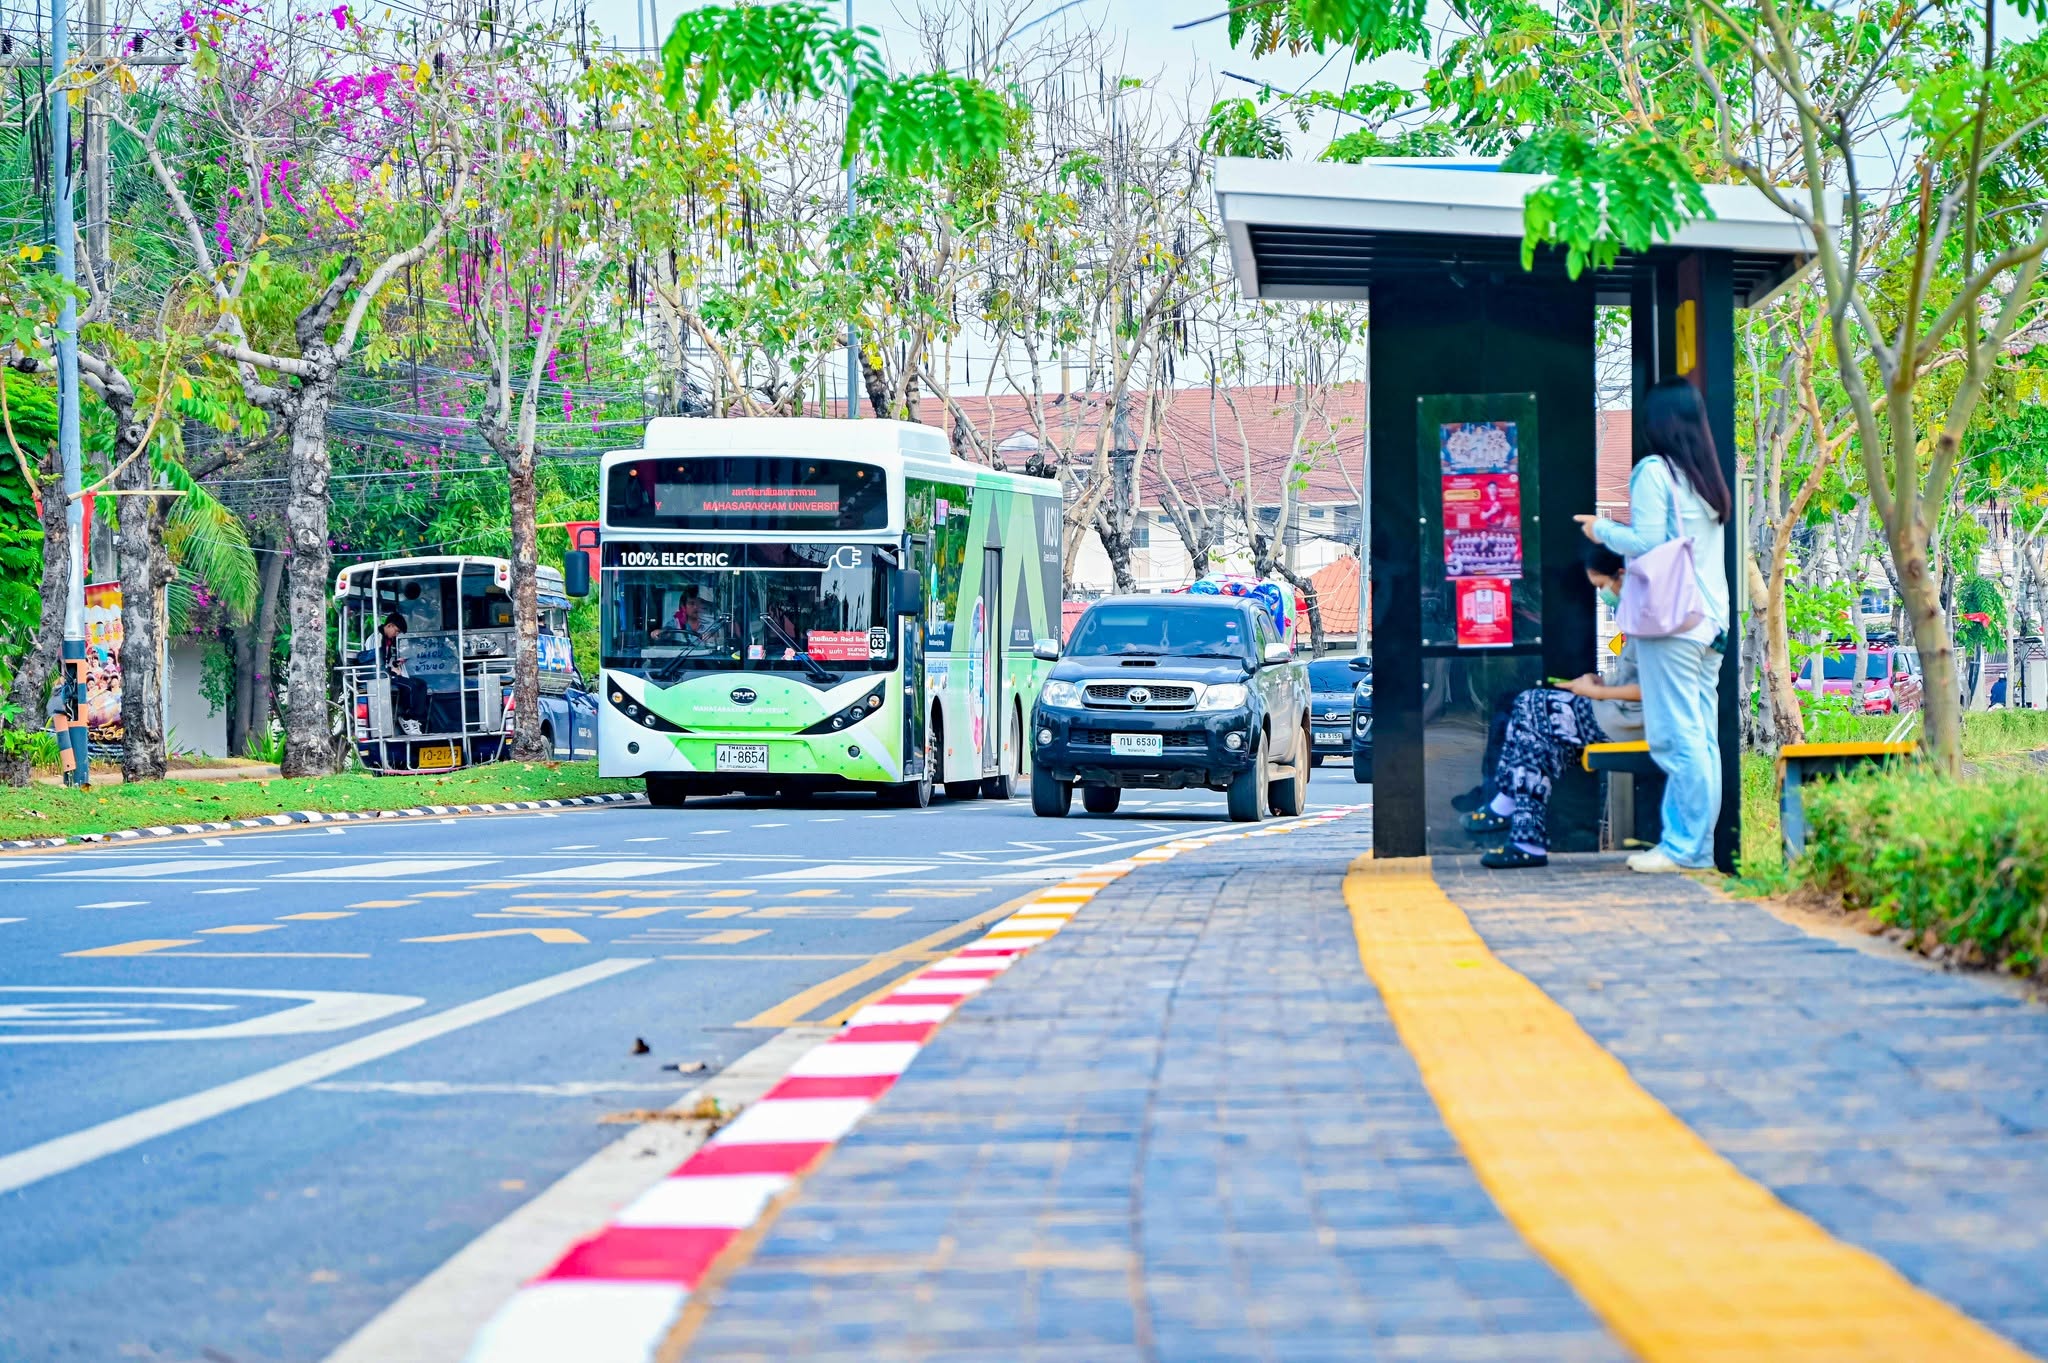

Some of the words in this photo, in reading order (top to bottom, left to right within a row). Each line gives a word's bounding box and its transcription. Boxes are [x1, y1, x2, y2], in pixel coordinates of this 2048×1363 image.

[703, 501, 787, 511] MAHASARAKHAM
[789, 501, 840, 511] UNIVERSIT
[620, 552, 659, 567] 100%
[661, 552, 729, 567] ELECTRIC
[871, 638, 885, 648] 03
[1136, 737, 1157, 747] 6530
[719, 750, 765, 764] 41-8654
[473, 905, 915, 919] BUS
[400, 927, 774, 945] EV
